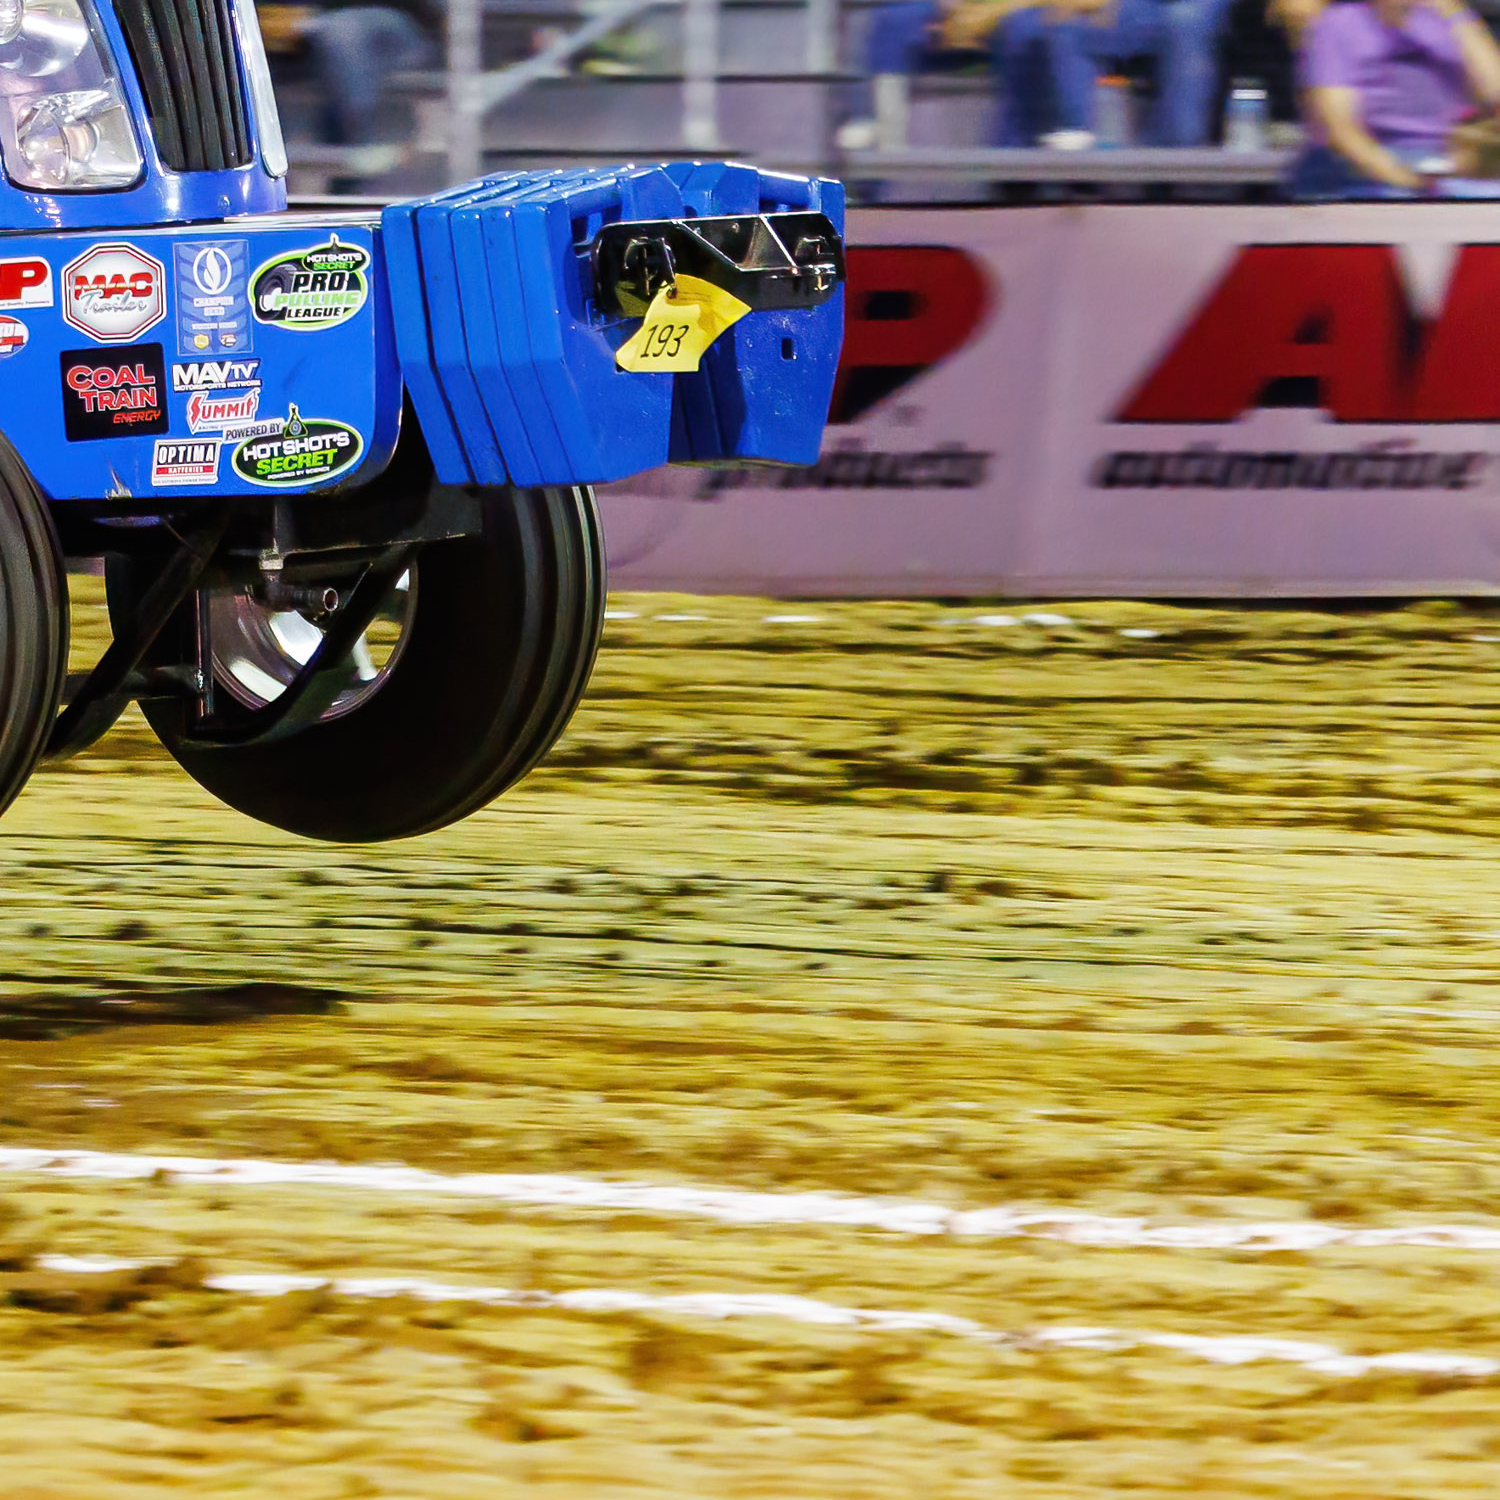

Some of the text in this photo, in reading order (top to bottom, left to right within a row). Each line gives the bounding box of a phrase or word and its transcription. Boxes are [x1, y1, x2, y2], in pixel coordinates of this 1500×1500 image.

[74, 272, 154, 301] MAC
[291, 271, 348, 293] PRO
[79, 289, 148, 315] Trailer
[273, 291, 361, 308] PULLING
[286, 306, 341, 319] LEAGUE
[640, 324, 689, 359] 193
[66, 363, 156, 391] COAL
[78, 386, 158, 412] TRAIN
[190, 396, 254, 425] SUMMIT
[113, 409, 163, 424] ENERGY
[226, 423, 282, 440] POWERED BY
[158, 444, 215, 464] OPTIMA
[256, 448, 338, 475] SECRET
